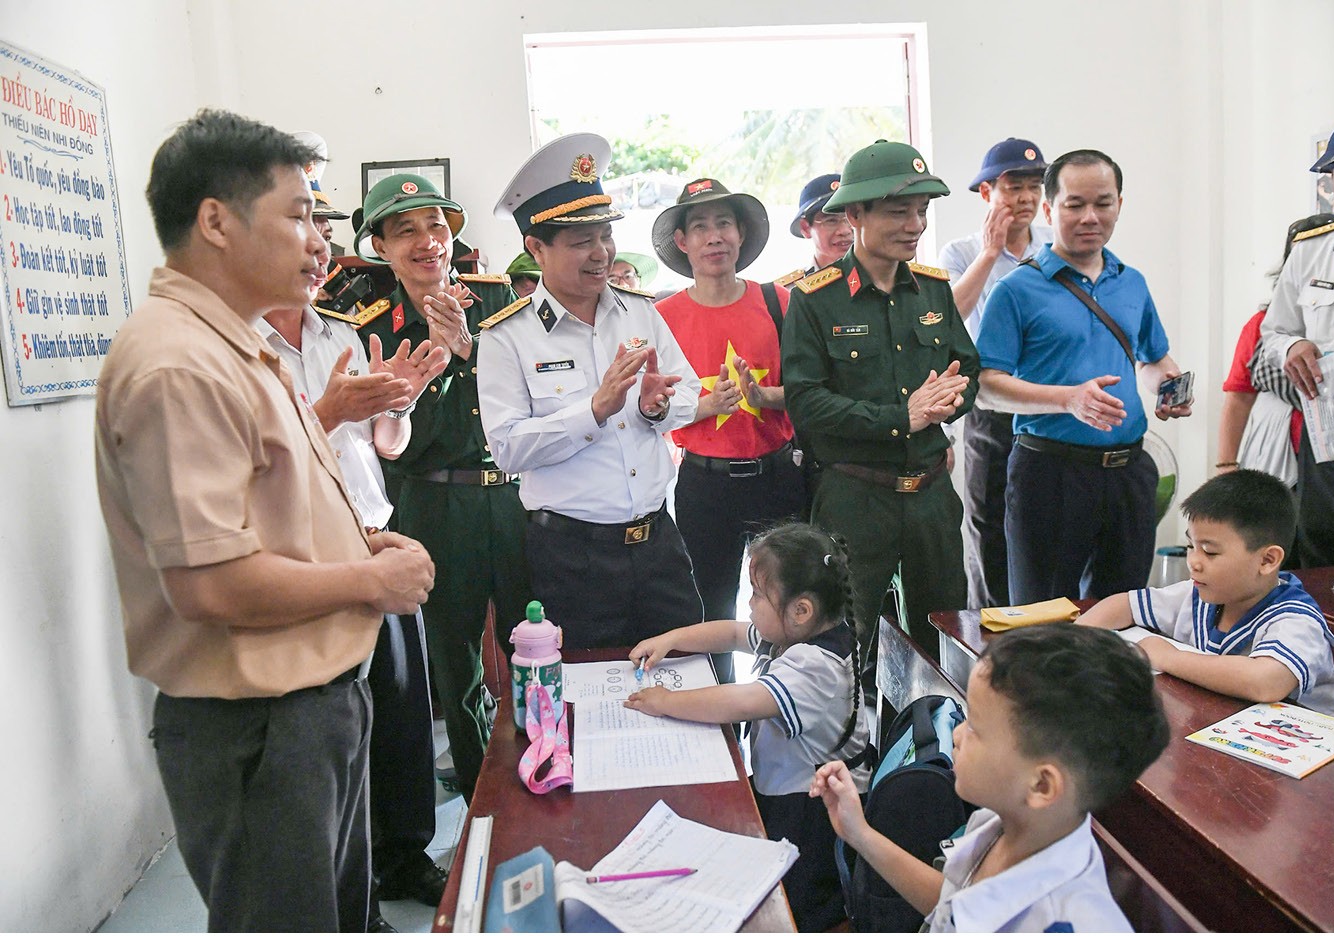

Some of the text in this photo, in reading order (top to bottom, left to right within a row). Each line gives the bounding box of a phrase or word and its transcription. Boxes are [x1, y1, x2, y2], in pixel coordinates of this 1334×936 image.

[1, 72, 97, 139] ĐIỀU BÁC HỒ DẠY
[2, 112, 28, 133] THIẾU
[31, 124, 50, 141] NIÊN
[53, 132, 67, 146] NHI
[7, 150, 23, 180] Yêu
[24, 153, 34, 183] Tổ
[36, 160, 57, 194] quốc,
[57, 168, 71, 194] yêu
[73, 168, 90, 201] đồng
[91, 175, 104, 200] bào
[13, 197, 29, 230] Học
[30, 202, 43, 233] tập
[44, 203, 60, 235] tốt,
[59, 208, 71, 233] lao
[73, 211, 91, 240] động
[92, 213, 103, 238] tốt
[20, 242, 40, 270] Đoàn
[41, 244, 54, 272] kết
[55, 246, 70, 278] tốt,
[80, 252, 95, 281] luật
[96, 252, 107, 277] tốt
[26, 288, 40, 314] Giữ
[41, 290, 53, 319] gìn
[54, 291, 63, 321] vệ
[65, 291, 79, 315] sinh
[80, 292, 96, 321] thật
[97, 291, 108, 316] tốt
[31, 333, 57, 359] Khiêm
